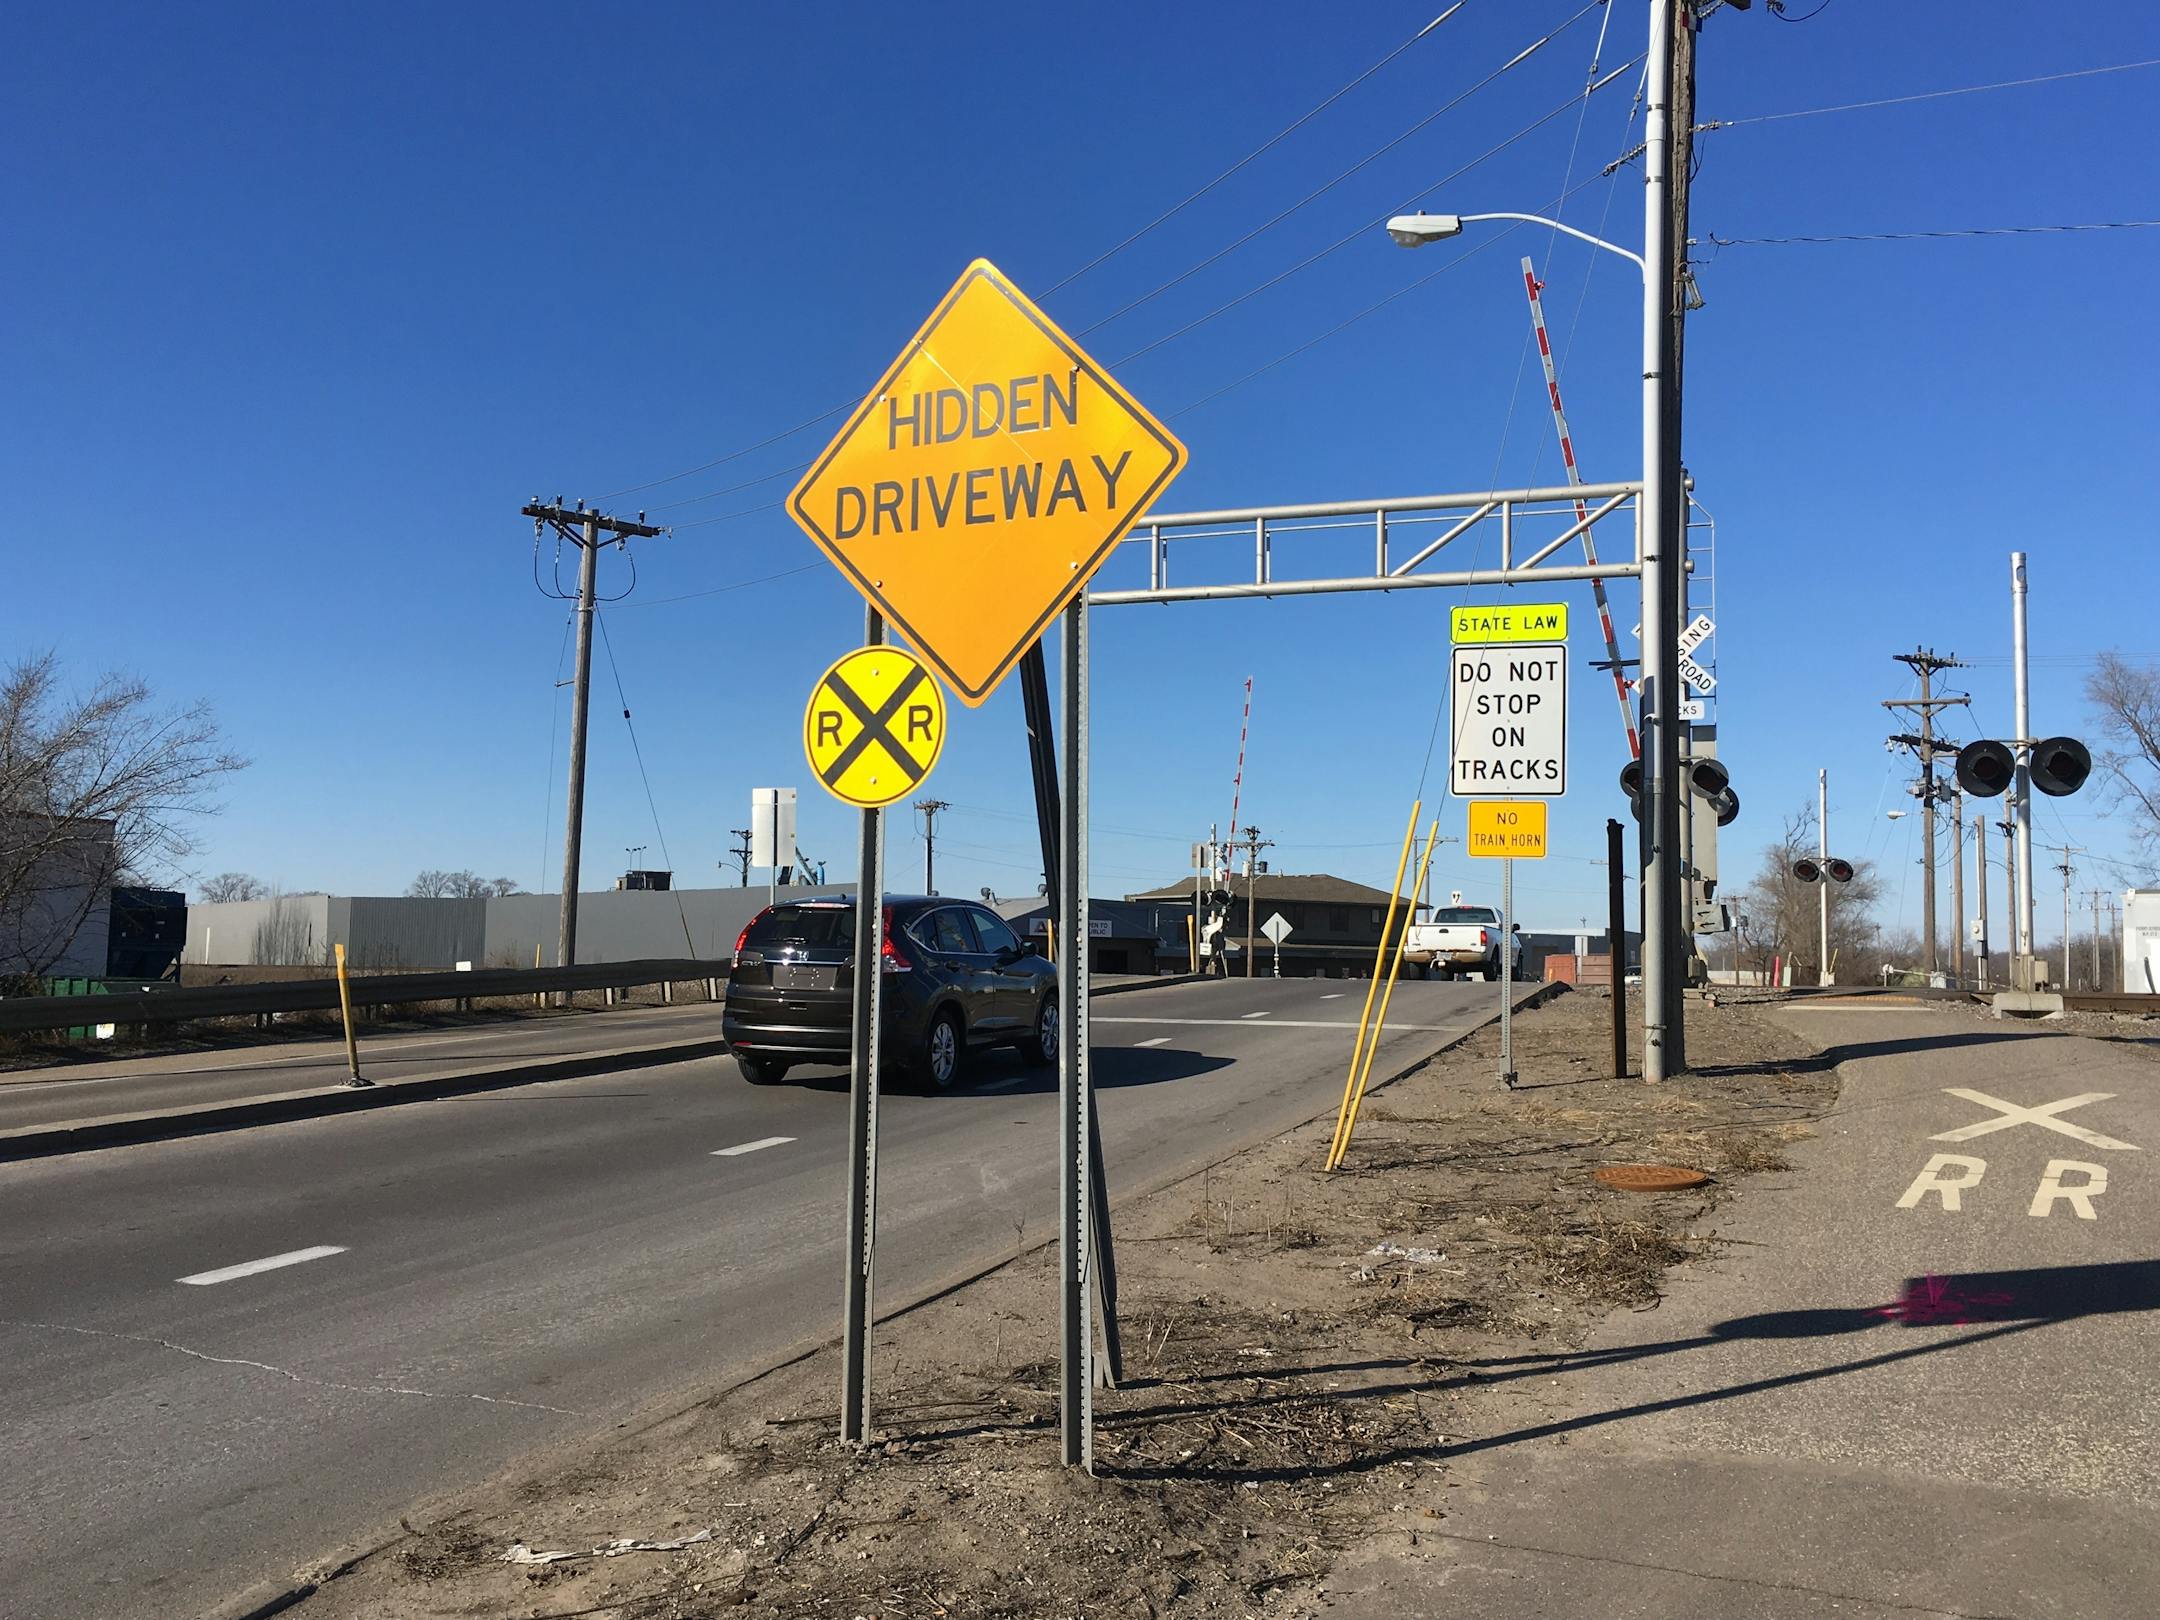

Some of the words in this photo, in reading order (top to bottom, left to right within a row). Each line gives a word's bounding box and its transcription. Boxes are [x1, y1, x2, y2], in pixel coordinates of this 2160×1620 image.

[889, 371, 1078, 450] HIDDEN
[834, 450, 1133, 541] DRIVEWAY
[1458, 616, 1511, 632] STATE
[1523, 615, 1558, 630] LAW
[1459, 662, 1491, 683] DO
[1509, 660, 1558, 682] NOT
[1476, 694, 1541, 715] STOP
[816, 711, 842, 748] R
[907, 704, 933, 743] R
[1492, 726, 1525, 748] ON
[1458, 759, 1559, 780] TRACKS
[1496, 812, 1518, 825] NO
[1473, 833, 1506, 847] TRAIN
[1511, 834, 1541, 847] HORN
[1895, 1153, 1987, 1212] R
[2028, 1159, 2109, 1221] R
